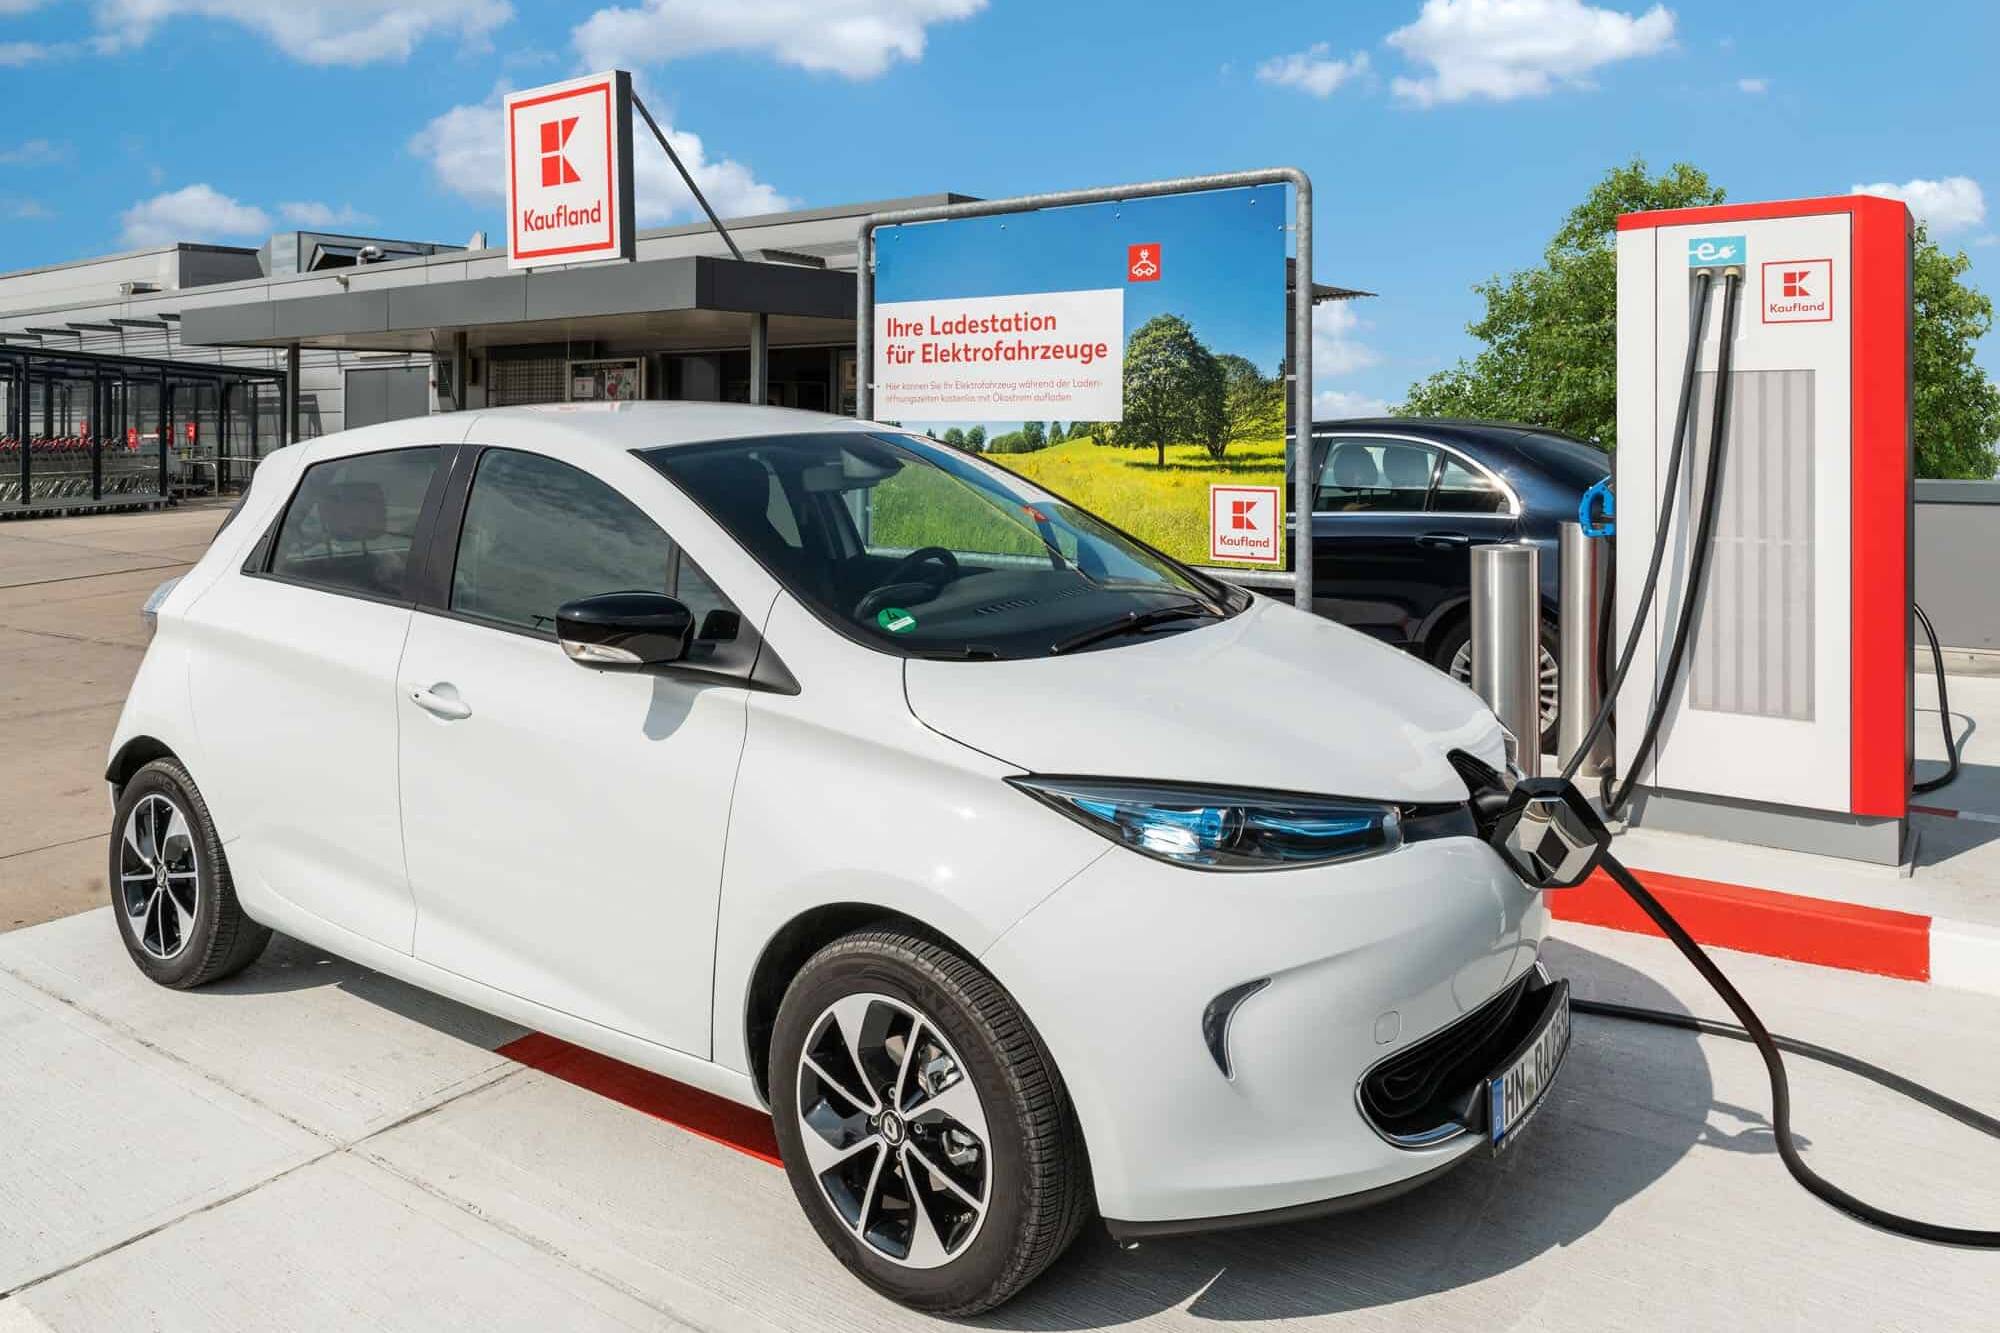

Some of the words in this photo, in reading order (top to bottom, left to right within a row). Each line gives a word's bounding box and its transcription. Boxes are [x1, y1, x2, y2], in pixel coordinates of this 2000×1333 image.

[524, 200, 601, 232] Kaufland
[1770, 302, 1825, 313] Kaufland
[886, 317, 924, 338] Ihre
[930, 312, 1057, 336] Ladestation
[886, 344, 915, 365] für
[921, 340, 1108, 365] Elektrofahrzeuge
[955, 379, 1017, 391] Elektrofahrzeug
[1018, 379, 1055, 390] während
[1056, 378, 1071, 389] der
[1033, 391, 1072, 402] aufladen
[1219, 534, 1269, 548] Kaufland
[1504, 1063, 1525, 1126] HN
[1535, 1033, 1550, 1091] RA
